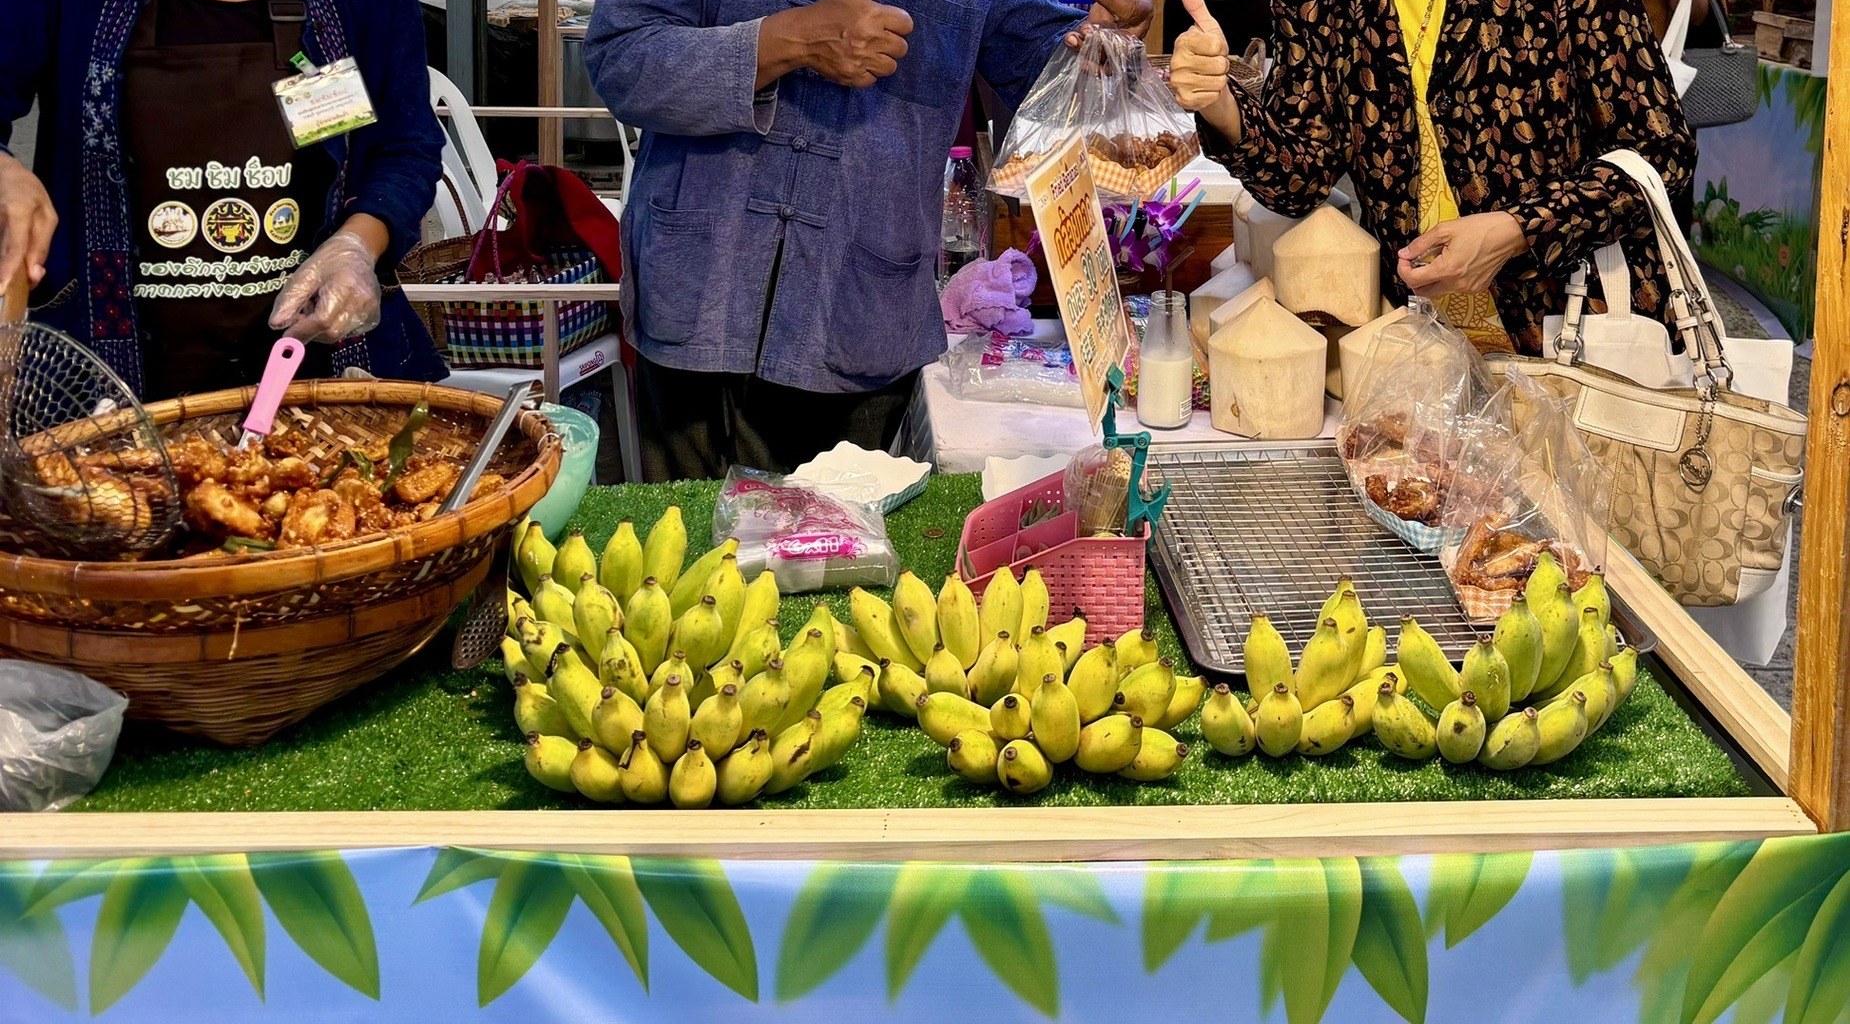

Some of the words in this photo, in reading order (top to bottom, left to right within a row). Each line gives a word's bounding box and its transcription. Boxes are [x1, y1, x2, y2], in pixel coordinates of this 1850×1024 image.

[166, 166, 203, 189] ชม
[205, 160, 241, 189] ชิม
[1053, 192, 1096, 269] กล้วยทอด
[133, 271, 293, 299] ภาคกลางตอนล่า
[1080, 246, 1098, 302] 30
